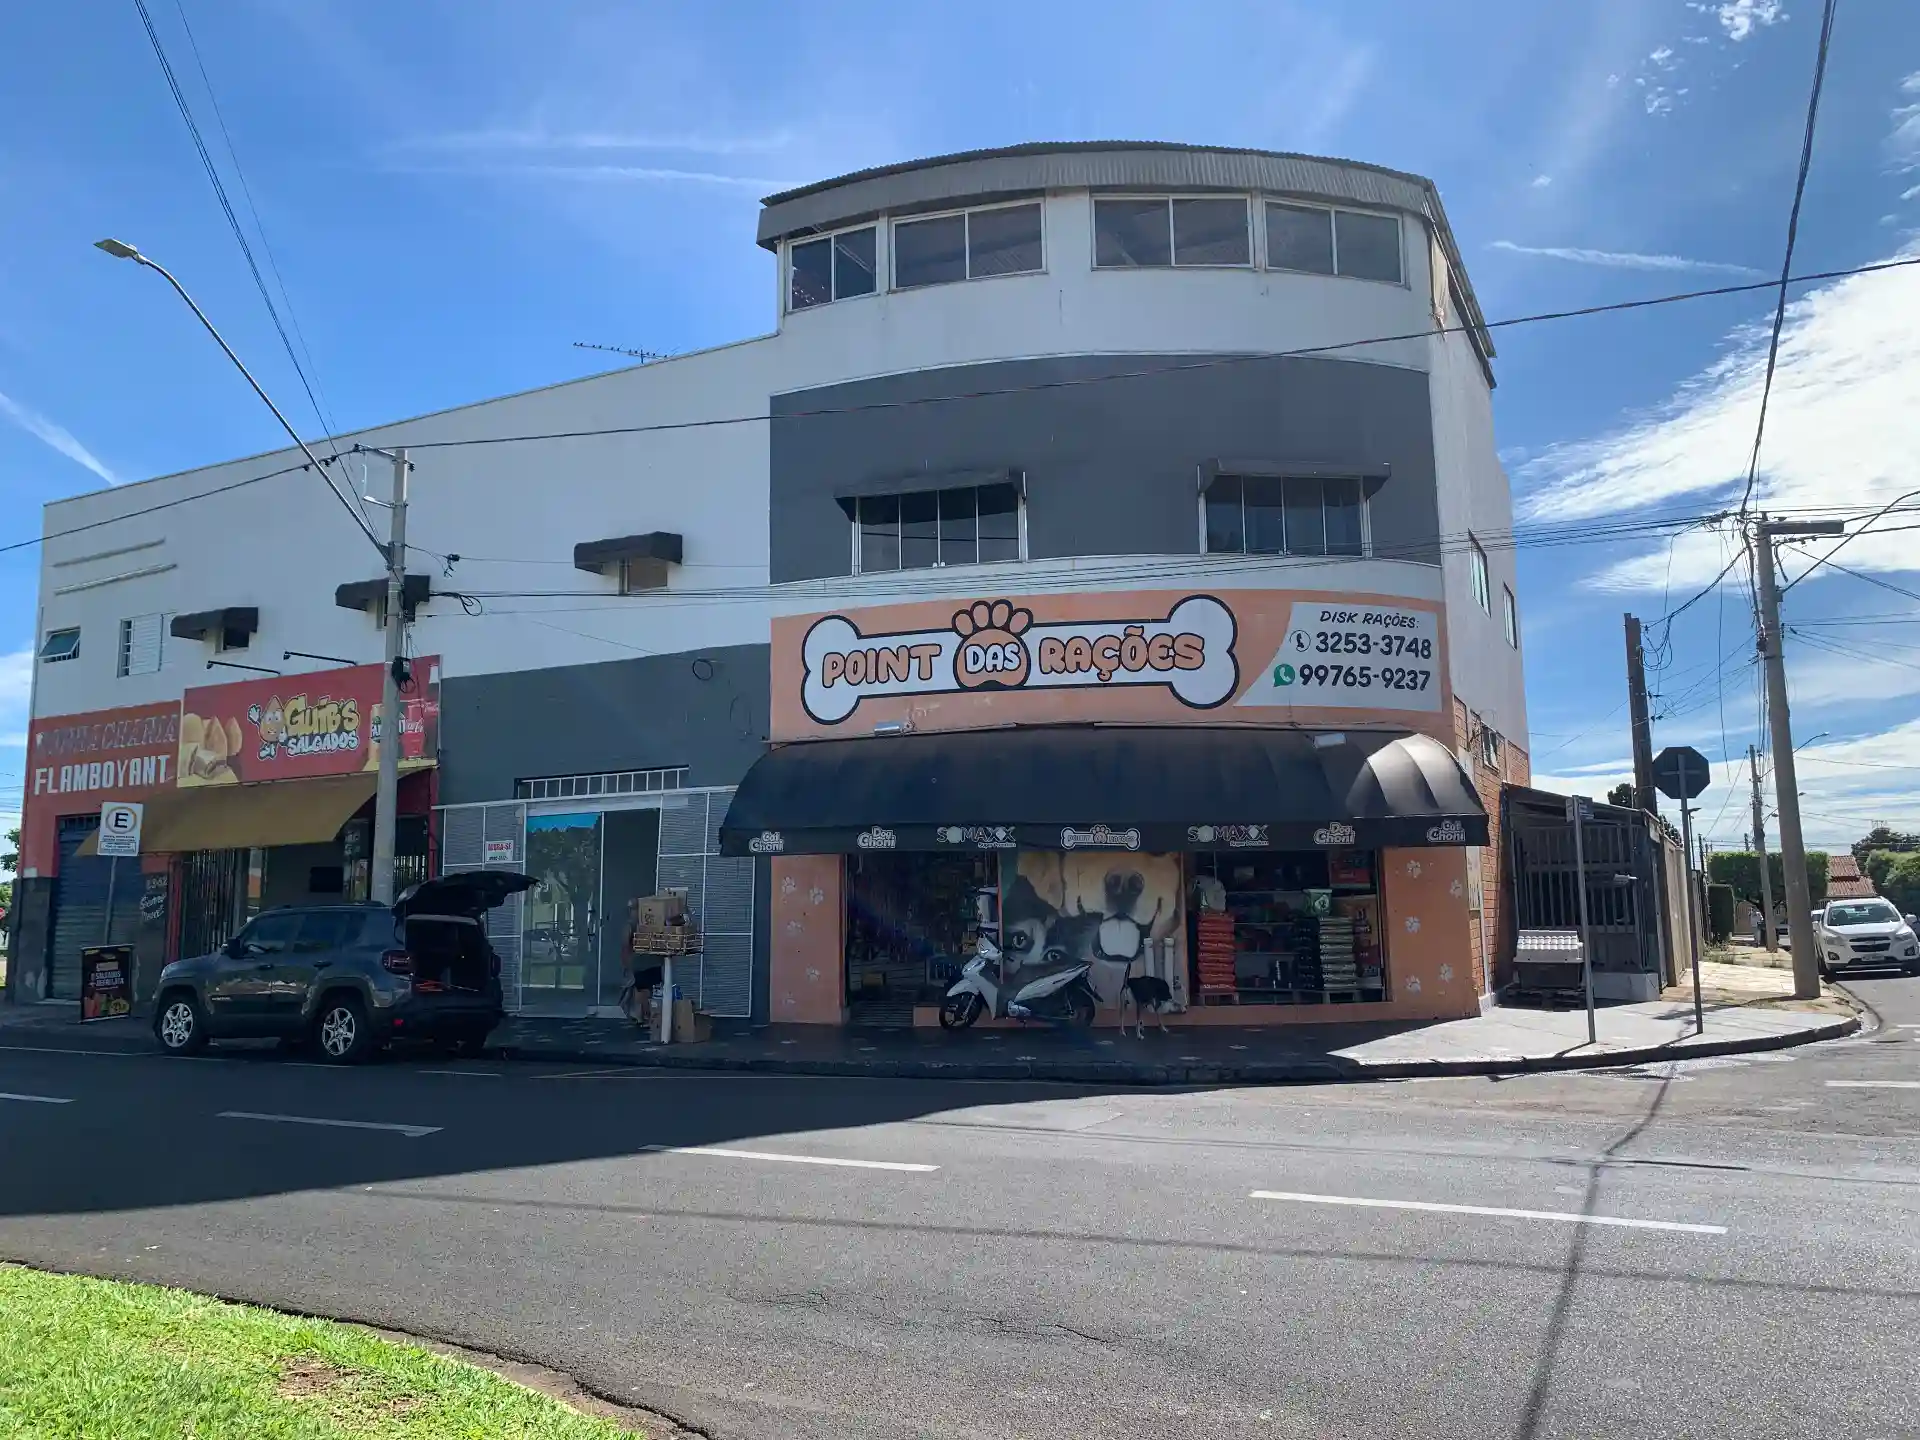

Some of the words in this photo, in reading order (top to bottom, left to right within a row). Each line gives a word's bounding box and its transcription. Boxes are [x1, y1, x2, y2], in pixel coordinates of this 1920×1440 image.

[1320, 611, 1358, 624] DISK
[822, 643, 942, 688] POINT
[964, 642, 1022, 674] DAS
[1039, 625, 1206, 681] RAÇÕES
[1315, 631, 1432, 659] 3253-3748
[1299, 664, 1431, 691] 99765-9237
[287, 731, 359, 755] SALGADOS
[34, 754, 171, 796] FLAMBOYANT
[114, 812, 129, 829] E
[872, 826, 894, 838] Dog
[1330, 822, 1353, 834] Dog
